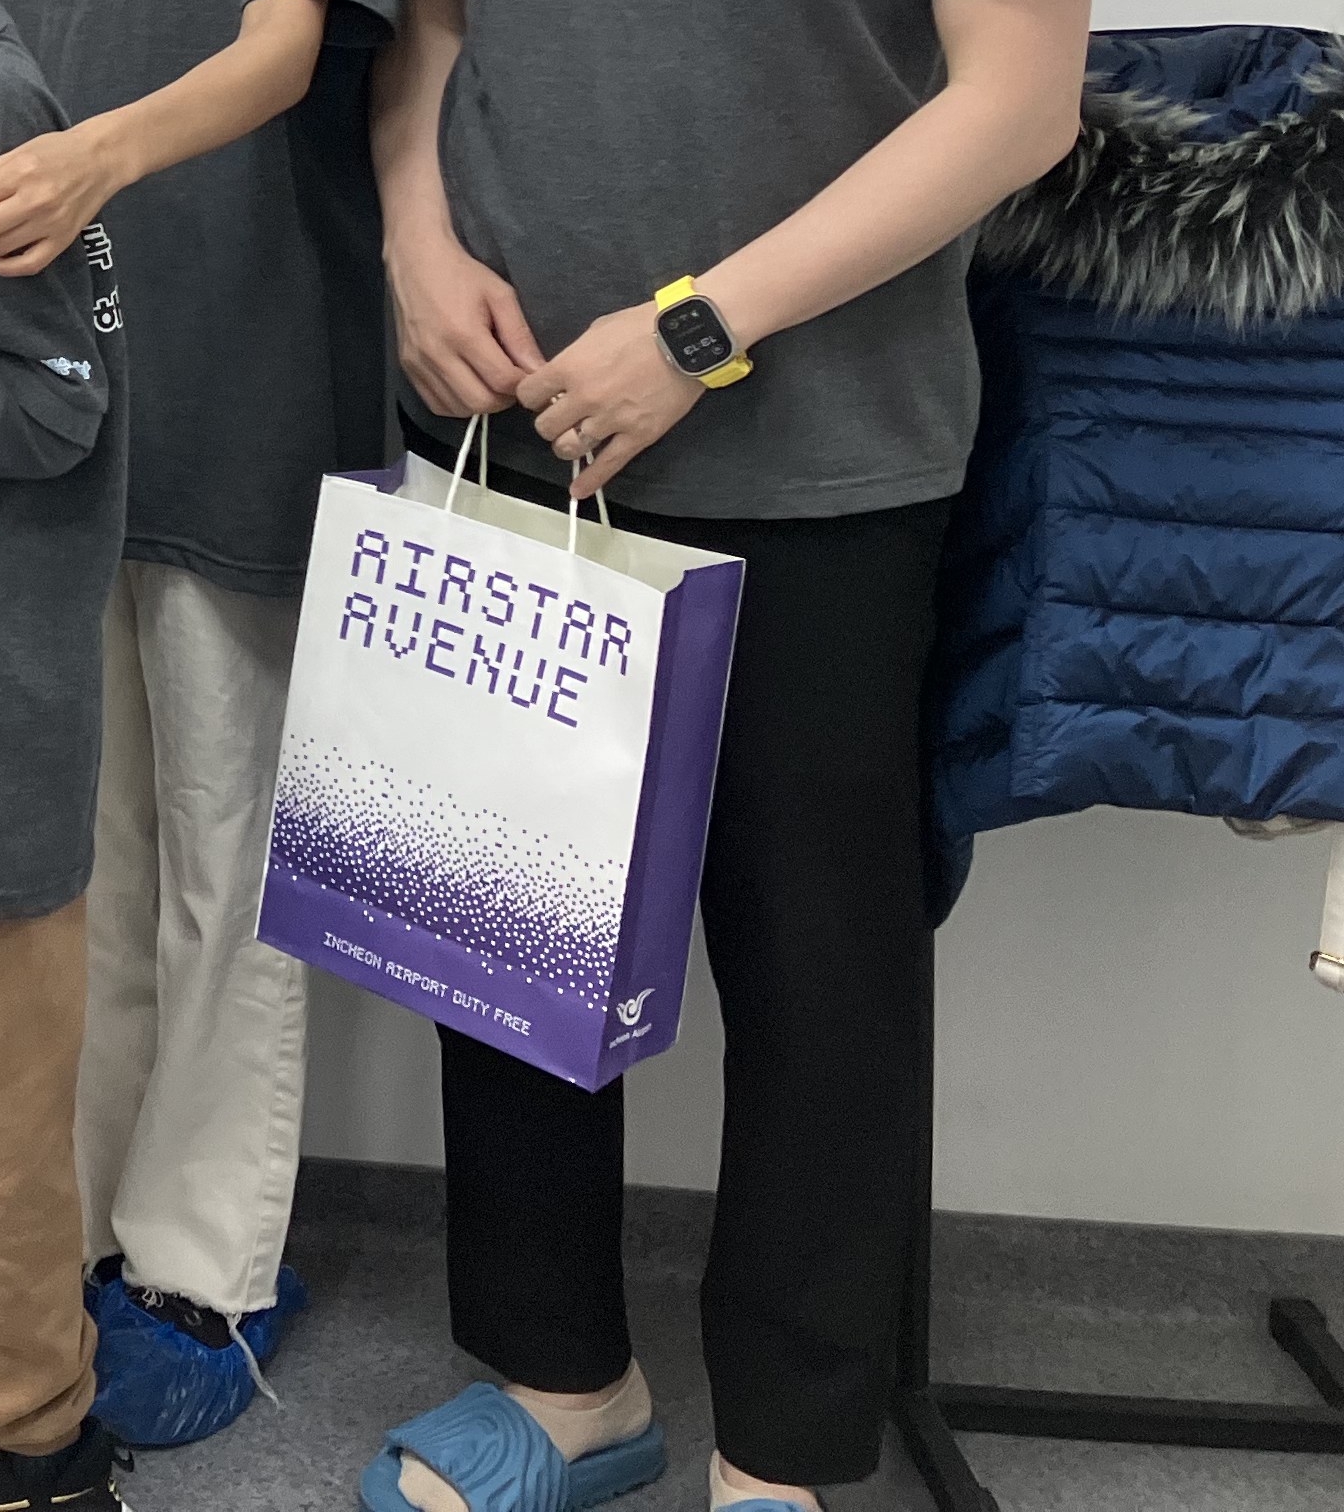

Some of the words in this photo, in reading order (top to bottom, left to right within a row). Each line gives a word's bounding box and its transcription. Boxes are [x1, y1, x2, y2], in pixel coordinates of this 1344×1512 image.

[338, 592, 590, 729] AVENUE
[350, 529, 635, 676] AIRSTAR
[322, 931, 383, 970] INCHEON
[385, 961, 449, 999] AIRPORT
[452, 989, 490, 1017] DUTY
[493, 1007, 532, 1037] FREE
